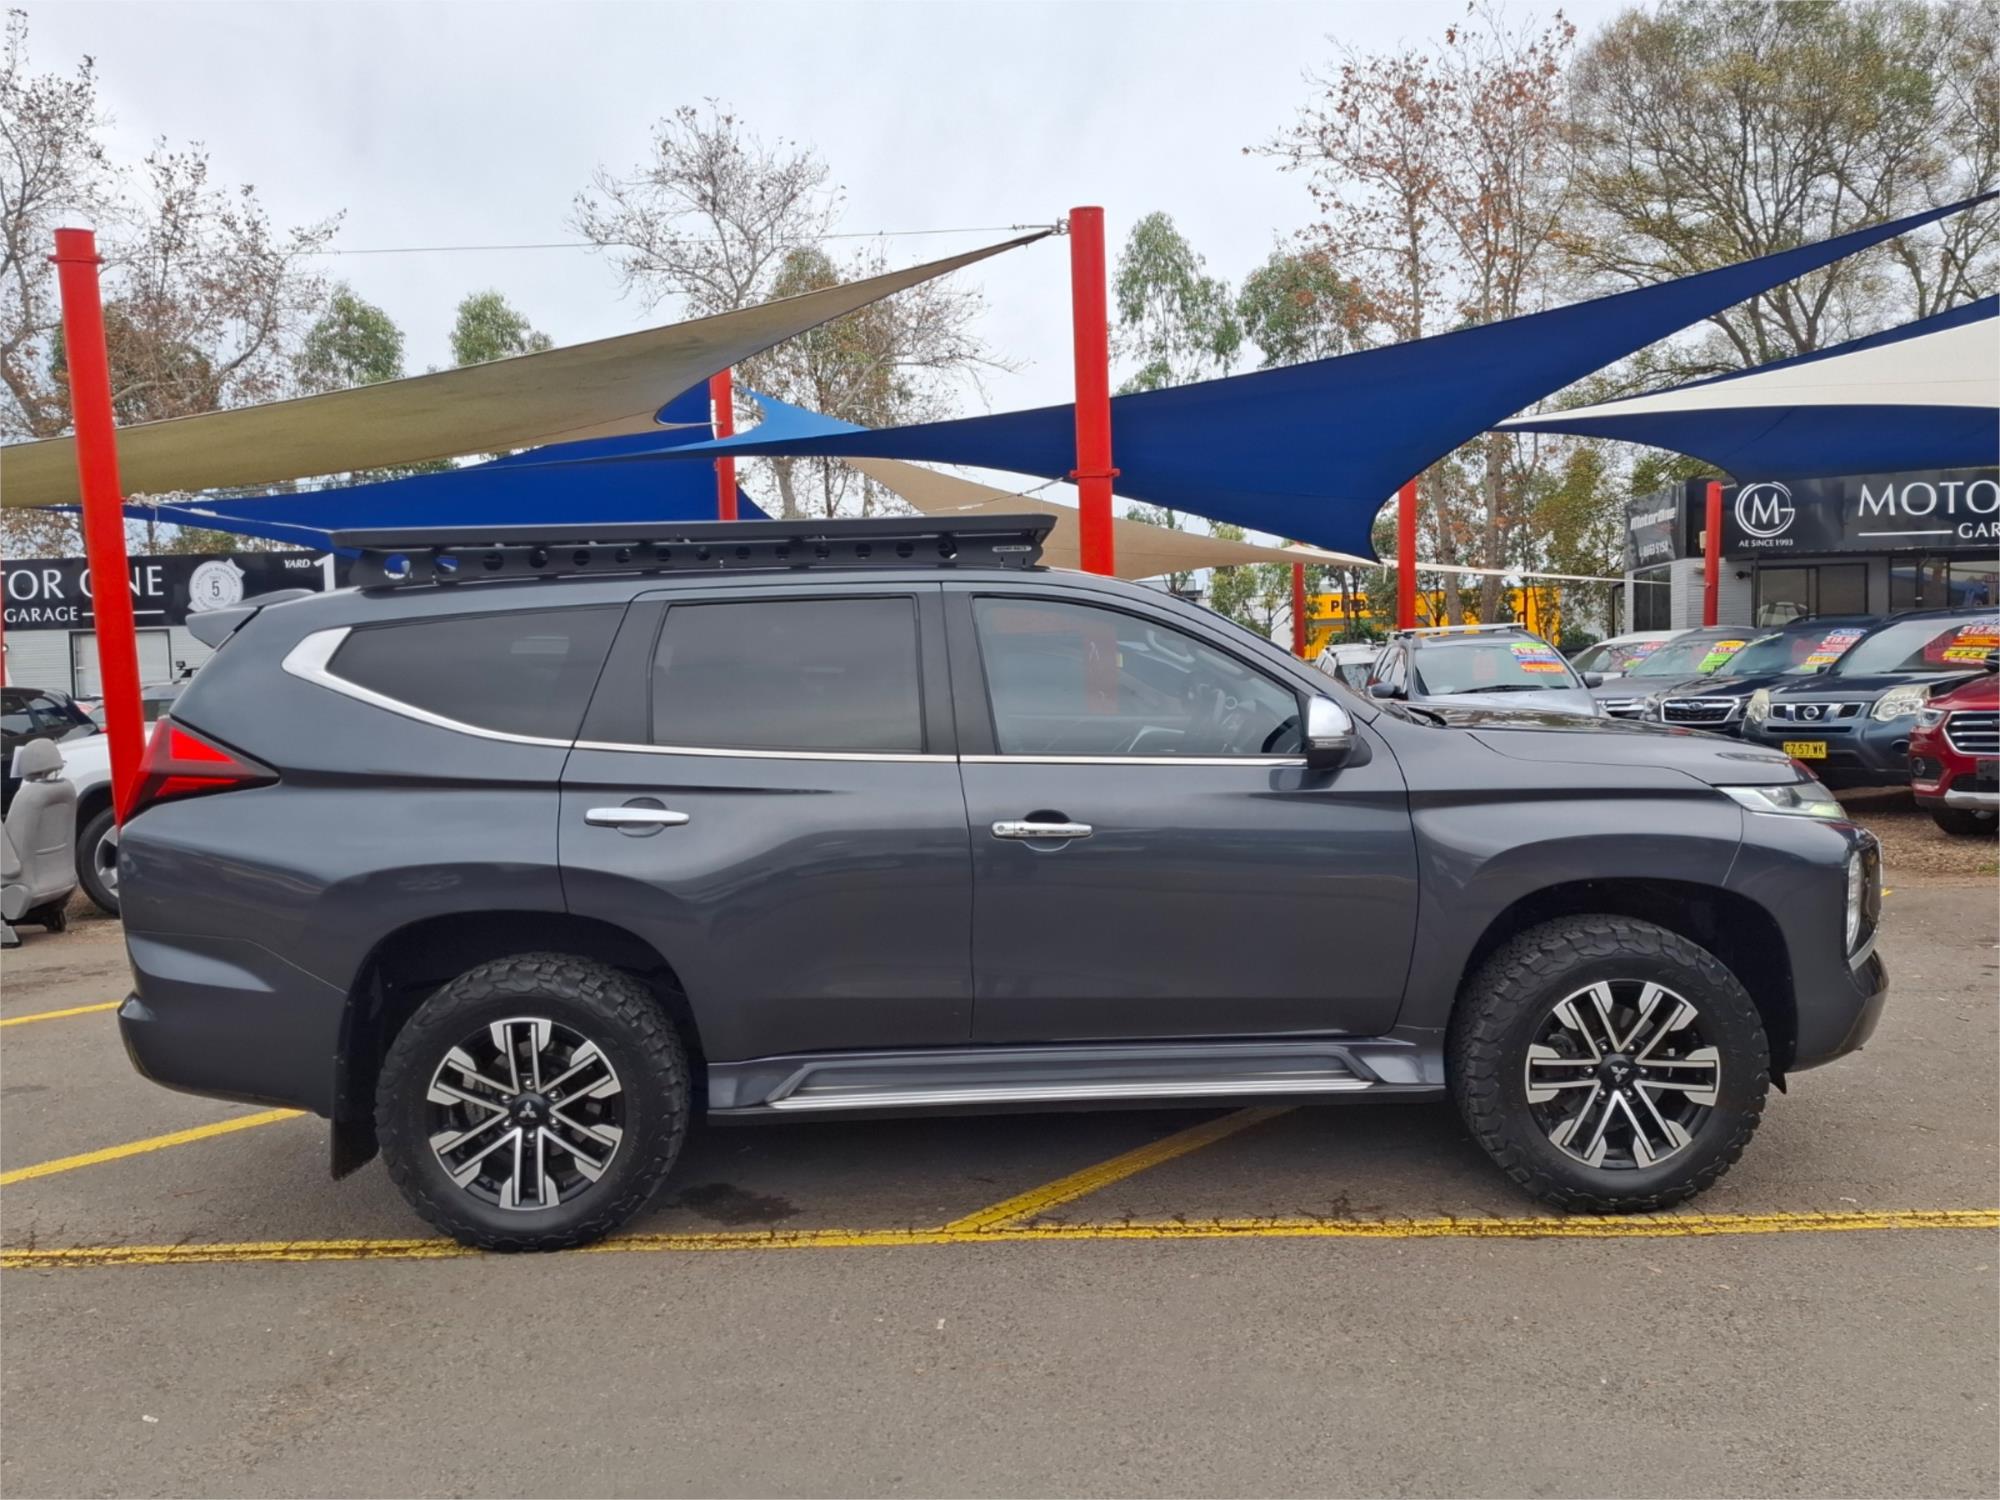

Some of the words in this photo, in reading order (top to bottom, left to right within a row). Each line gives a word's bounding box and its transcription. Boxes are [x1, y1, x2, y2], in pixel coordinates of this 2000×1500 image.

[1858, 480, 2000, 516] MOTO
[1751, 539, 1774, 547] SINCE
[284, 559, 310, 568] YARD
[313, 553, 335, 592] 1
[0, 569, 65, 601] OR
[211, 580, 220, 597] 5
[4, 606, 78, 623] GARAGE
